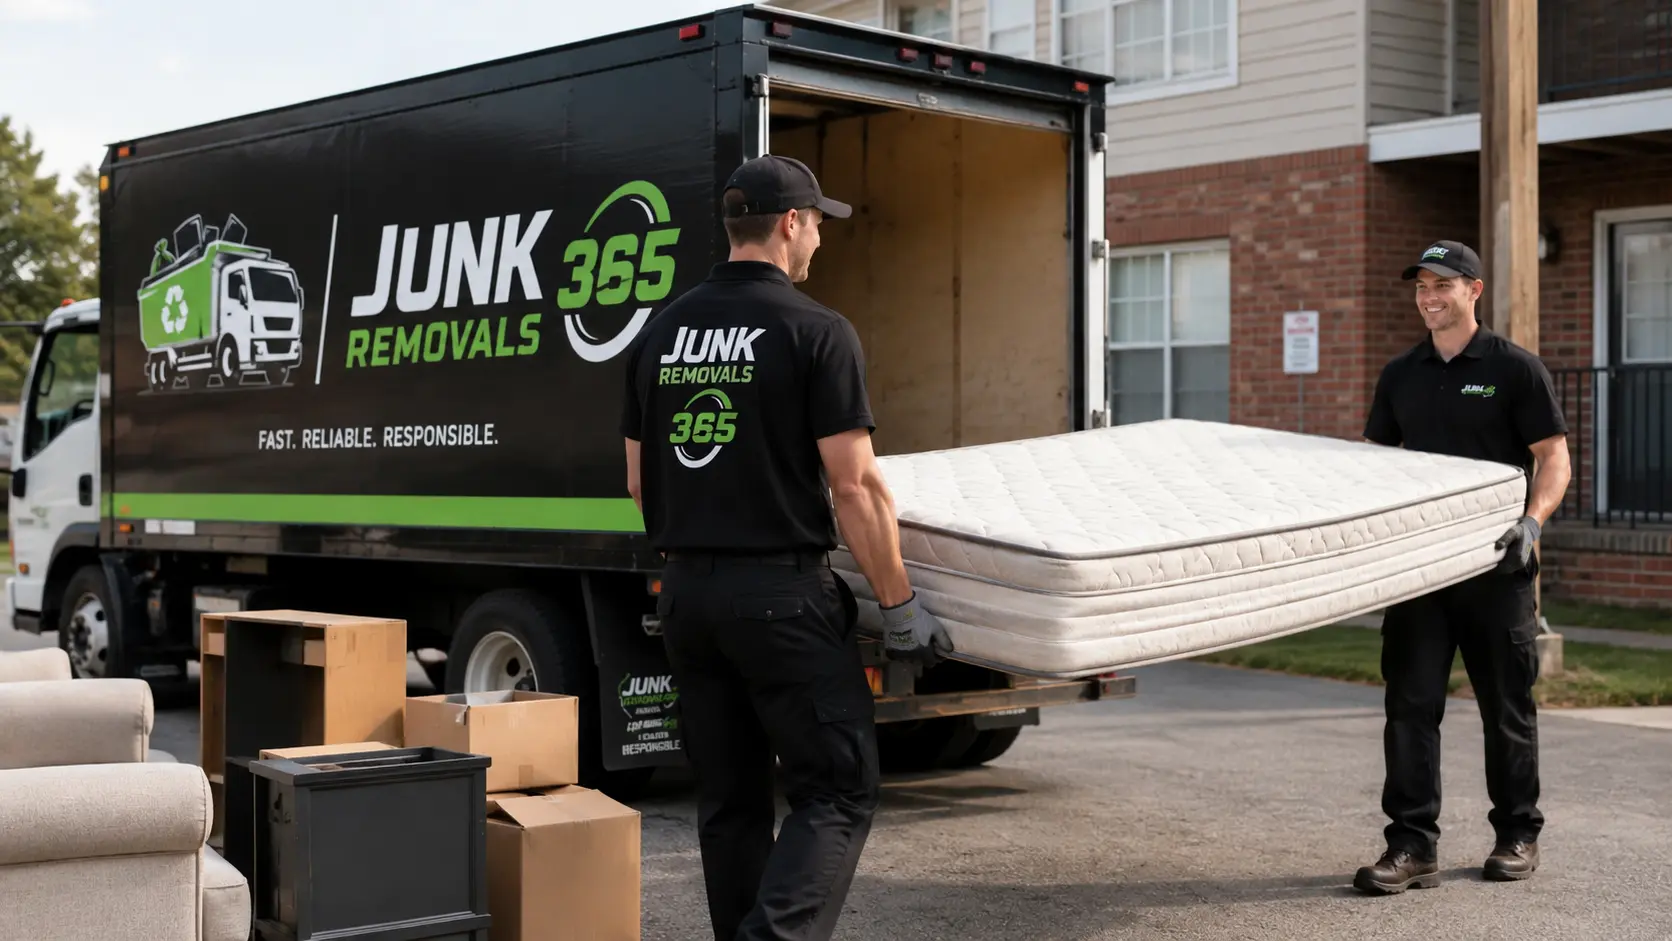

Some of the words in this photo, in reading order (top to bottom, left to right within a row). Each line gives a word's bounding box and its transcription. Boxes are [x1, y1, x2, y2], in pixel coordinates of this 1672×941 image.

[350, 209, 554, 317] JUNK
[556, 227, 681, 309] 365
[345, 313, 542, 369] REMOVALS
[660, 326, 767, 364] JUNK
[658, 365, 754, 385] REMOVALS
[258, 429, 296, 450] FAST.
[302, 426, 377, 449] RELIABLE.
[383, 423, 499, 448] RESPONSIBLE.
[669, 411, 739, 444] 365
[621, 675, 673, 697] JUNK
